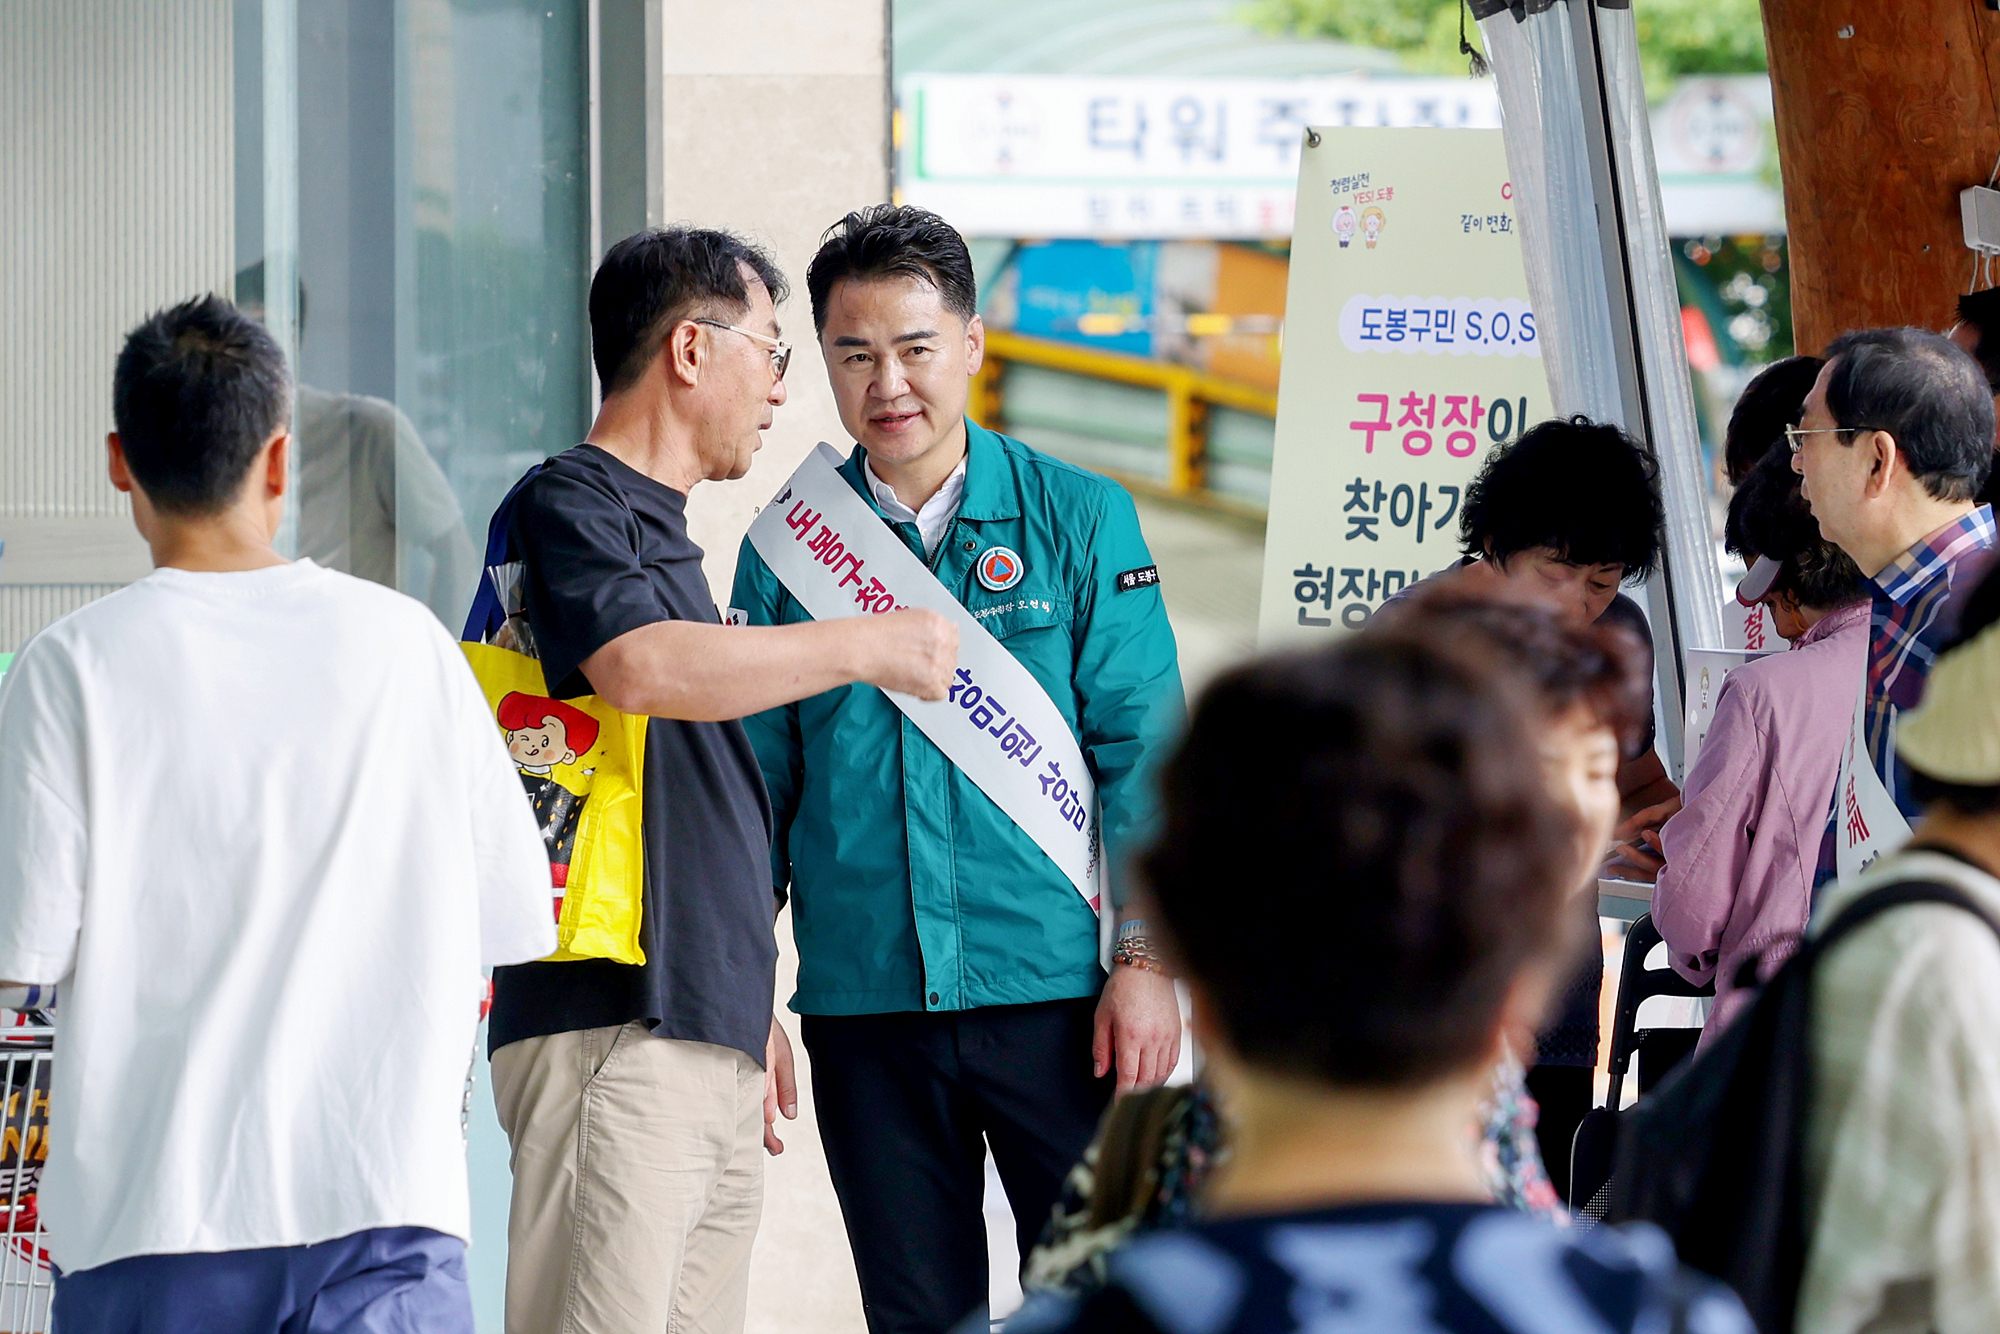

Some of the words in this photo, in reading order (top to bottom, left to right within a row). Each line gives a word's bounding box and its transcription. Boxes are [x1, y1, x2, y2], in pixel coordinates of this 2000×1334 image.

[1088, 96, 1228, 163] 타워
[1330, 172, 1370, 194] 청렴실천
[1352, 190, 1374, 205] YES!
[1376, 186, 1395, 201] 도봉
[1460, 214, 1483, 233] 같이
[1360, 308, 1455, 343] 도봉구민
[1349, 391, 1527, 458] 구청장이
[786, 500, 909, 614] 도봉구청
[1038, 761, 1087, 832] 상담
